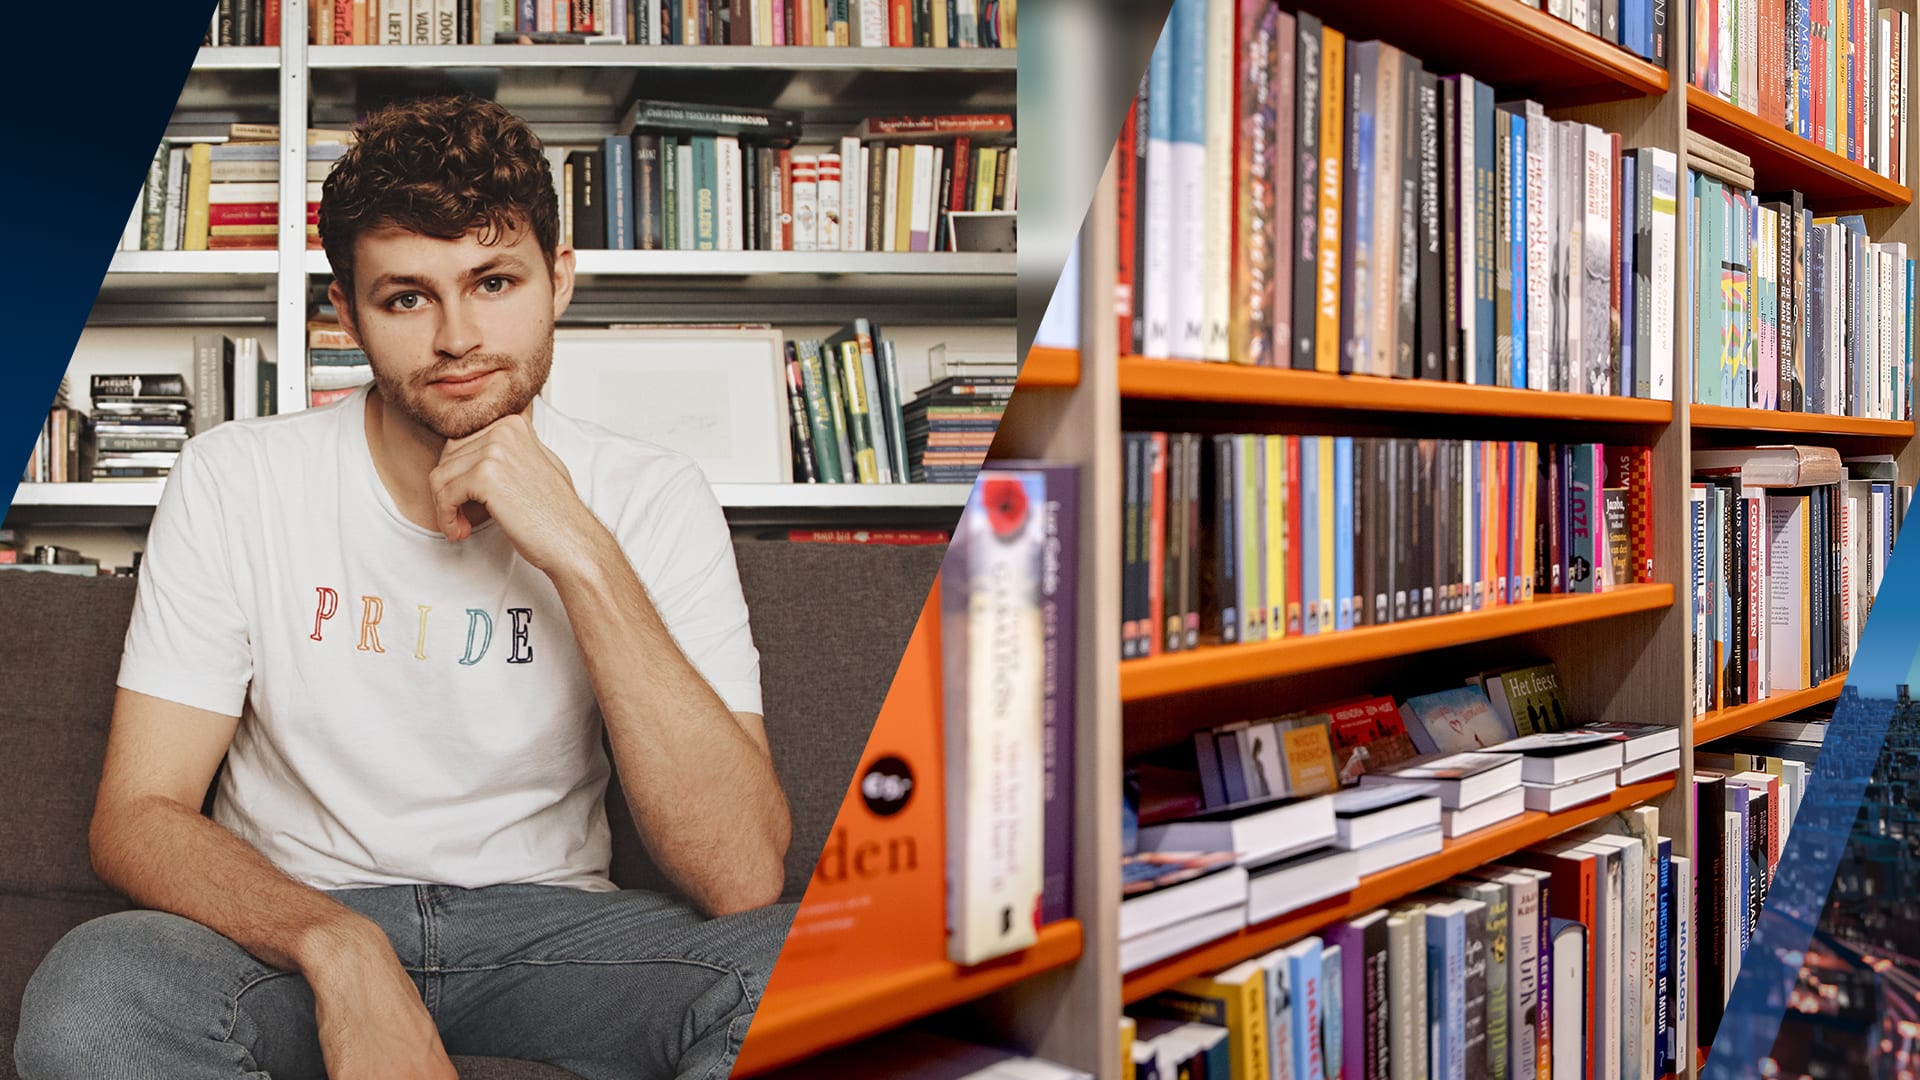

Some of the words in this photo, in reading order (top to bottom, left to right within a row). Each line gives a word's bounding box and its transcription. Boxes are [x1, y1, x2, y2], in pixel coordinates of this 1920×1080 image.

[1801, 21, 1810, 101] MOSSE
[721, 113, 769, 126] BARRACUDA
[1322, 157, 1337, 196] UIT
[698, 188, 713, 237] GOLDEN
[1535, 157, 1543, 244] HERMAN
[1322, 205, 1337, 239] DE
[1322, 247, 1337, 319] MAAT
[1535, 251, 1543, 308] KOCH
[1781, 286, 1786, 298] DE
[1786, 287, 1791, 299] DE
[1781, 324, 1786, 336] EN
[1786, 325, 1791, 337] EN
[1697, 499, 1705, 588] MOTHERWELL
[1736, 530, 1742, 549] OZ
[1750, 503, 1758, 568] CONNIE
[1750, 569, 1758, 639] PALMEN
[310, 586, 533, 666] PRIDE
[1510, 677, 1530, 698] Het
[1531, 672, 1557, 695] feest
[1658, 855, 1669, 888] JOHN
[1658, 892, 1669, 973] LANCHESTER
[1658, 976, 1669, 994] DE
[1679, 920, 1688, 1022] NAAMLOOS
[1540, 987, 1549, 1039] NACHT
[1658, 995, 1669, 1035] MUUR
[1540, 1044, 1549, 1067] EN
